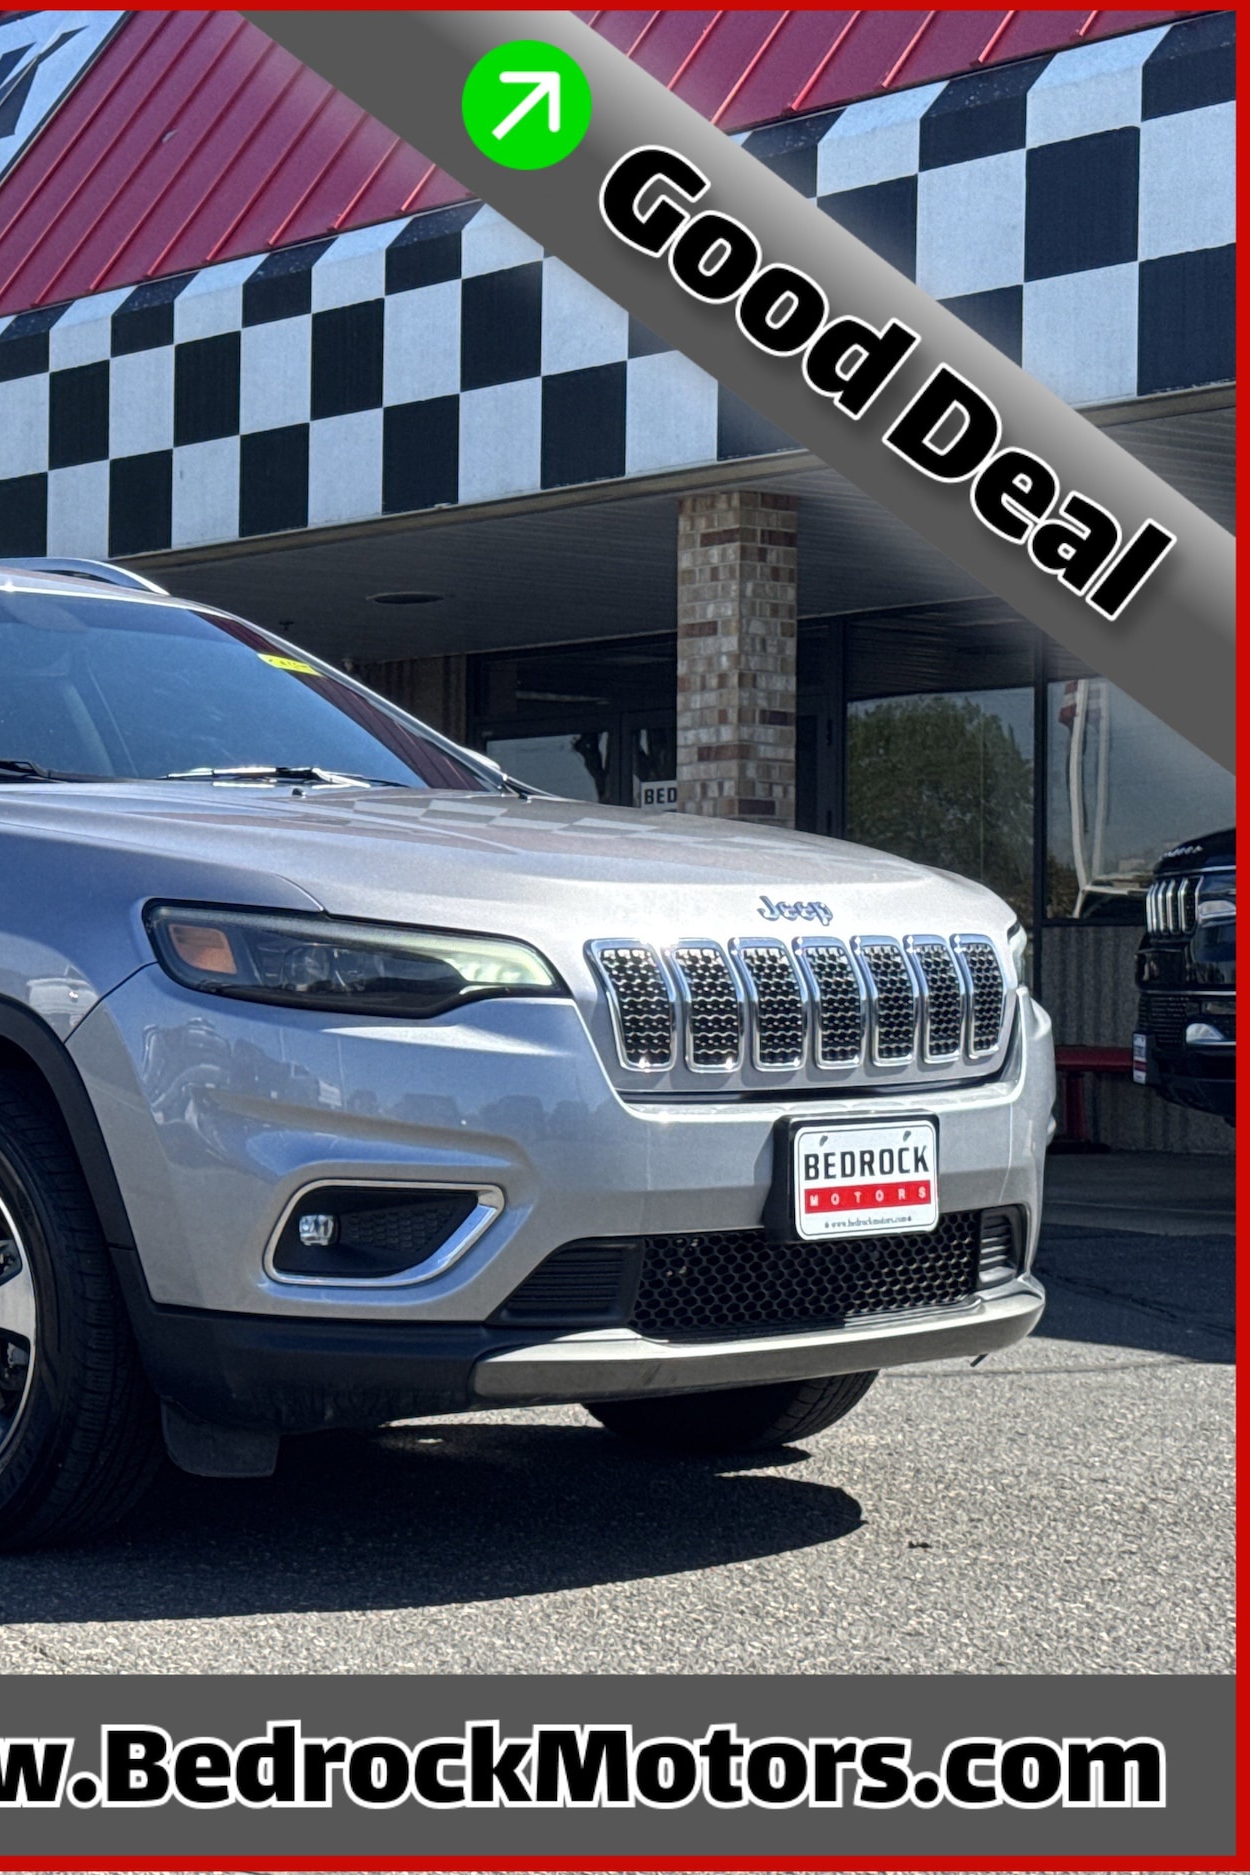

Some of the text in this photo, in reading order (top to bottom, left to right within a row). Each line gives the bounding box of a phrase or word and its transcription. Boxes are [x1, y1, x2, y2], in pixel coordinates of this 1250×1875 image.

[756, 895, 833, 926] Jeep
[804, 1145, 929, 1181] BEDROCK
[809, 1186, 927, 1207] MOTORS
